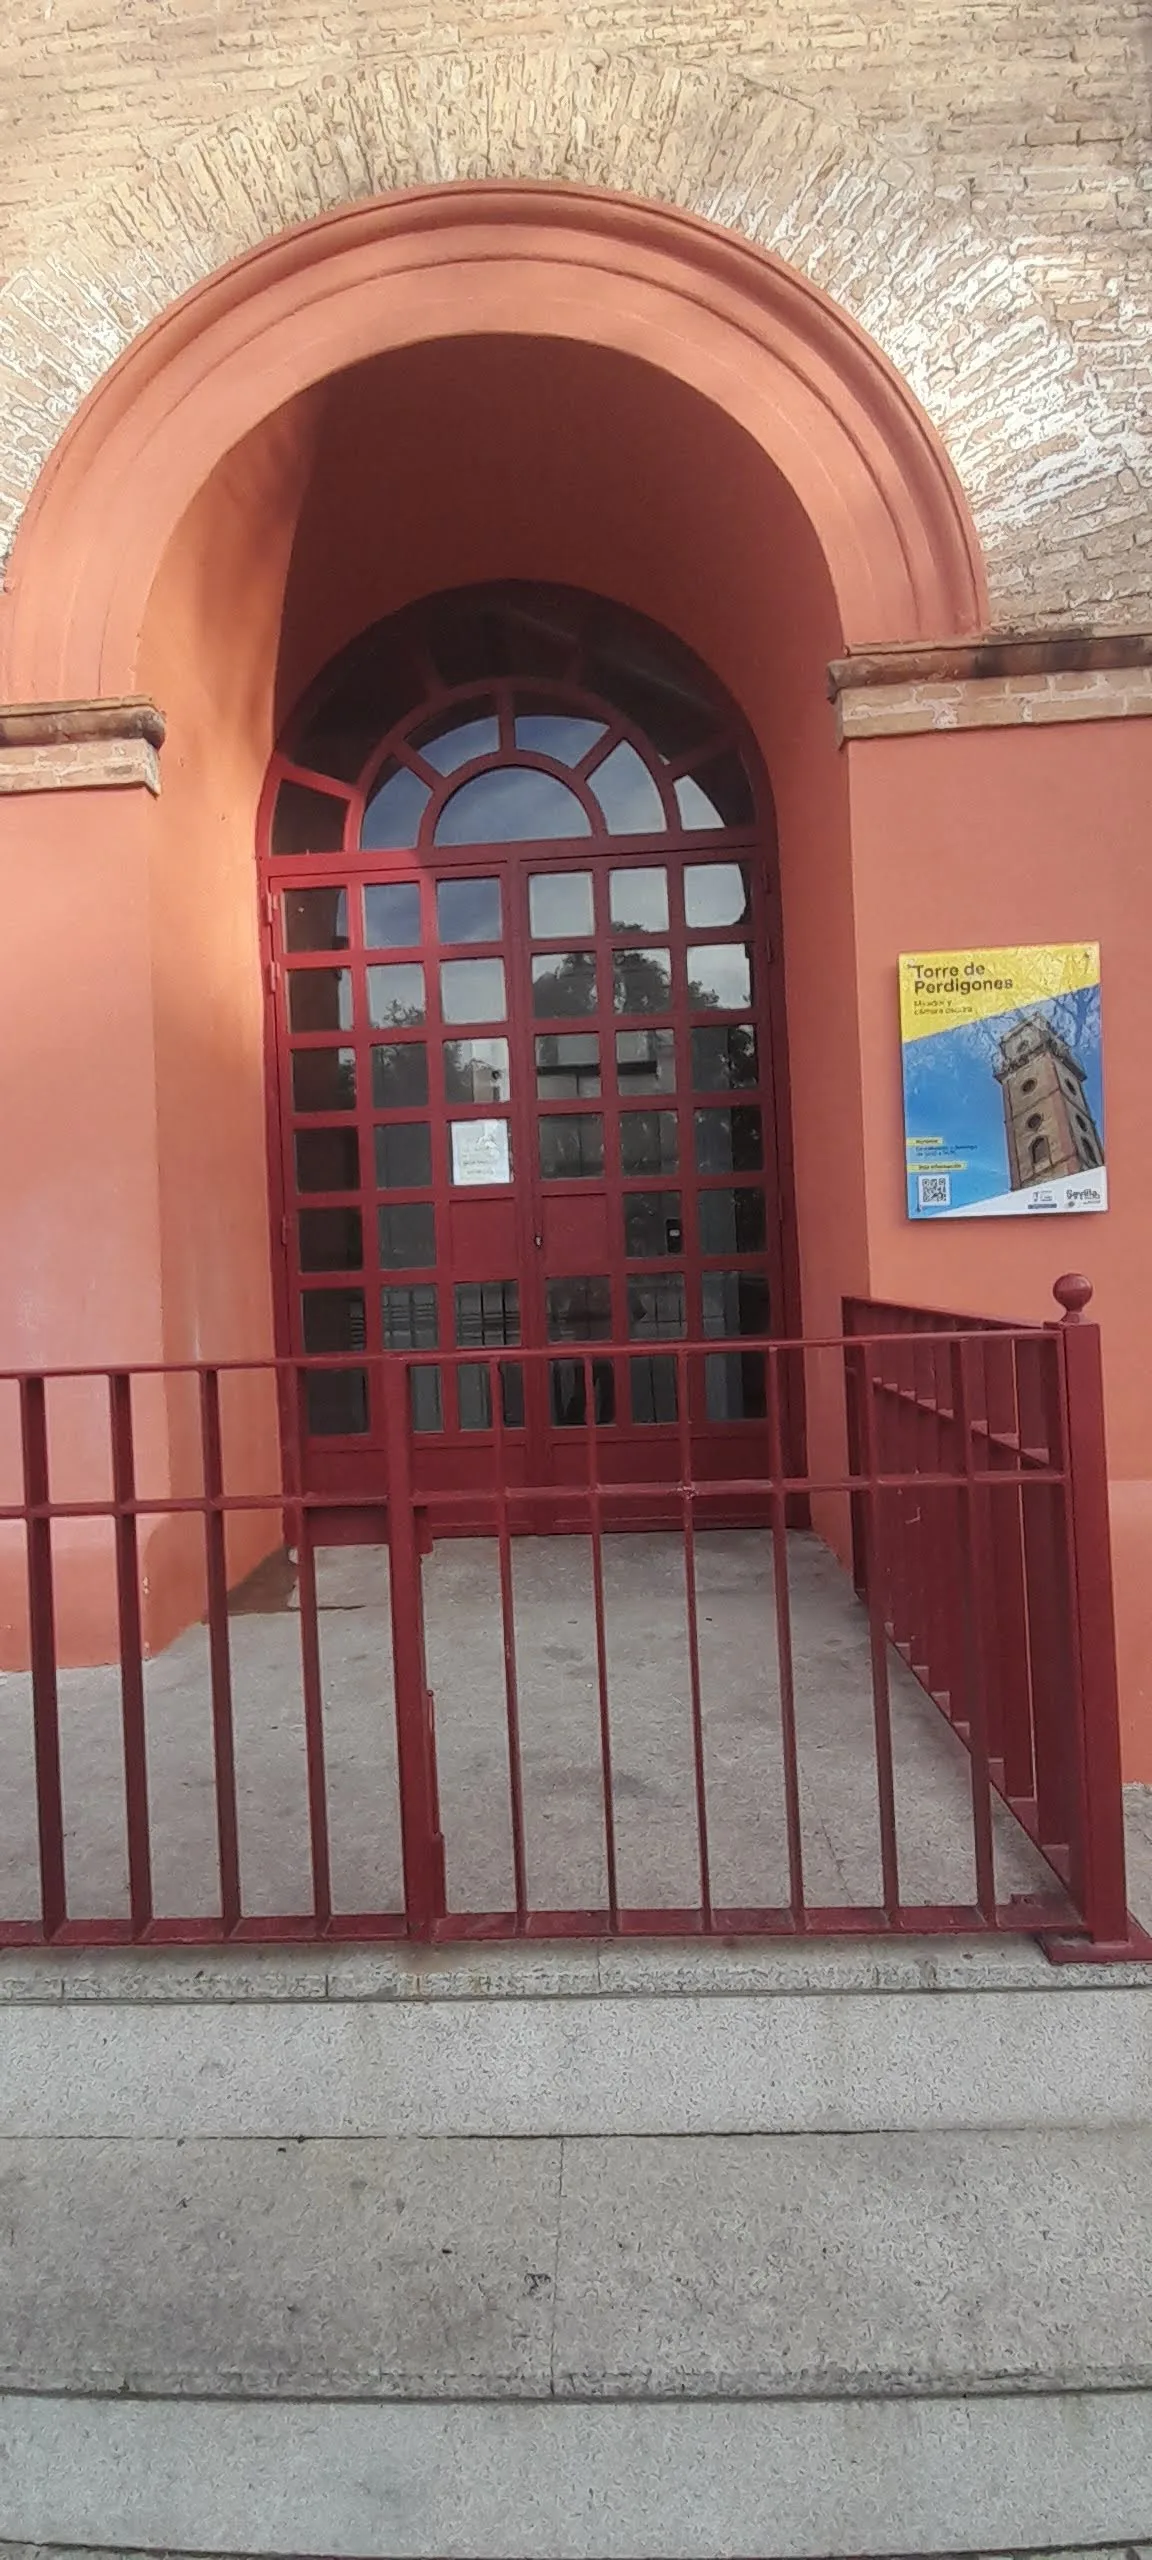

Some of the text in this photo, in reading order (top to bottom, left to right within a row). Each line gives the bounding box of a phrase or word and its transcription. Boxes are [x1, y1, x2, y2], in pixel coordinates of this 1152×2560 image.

[914, 961, 985, 979] Torre de
[914, 978, 1013, 996] Perdigones
